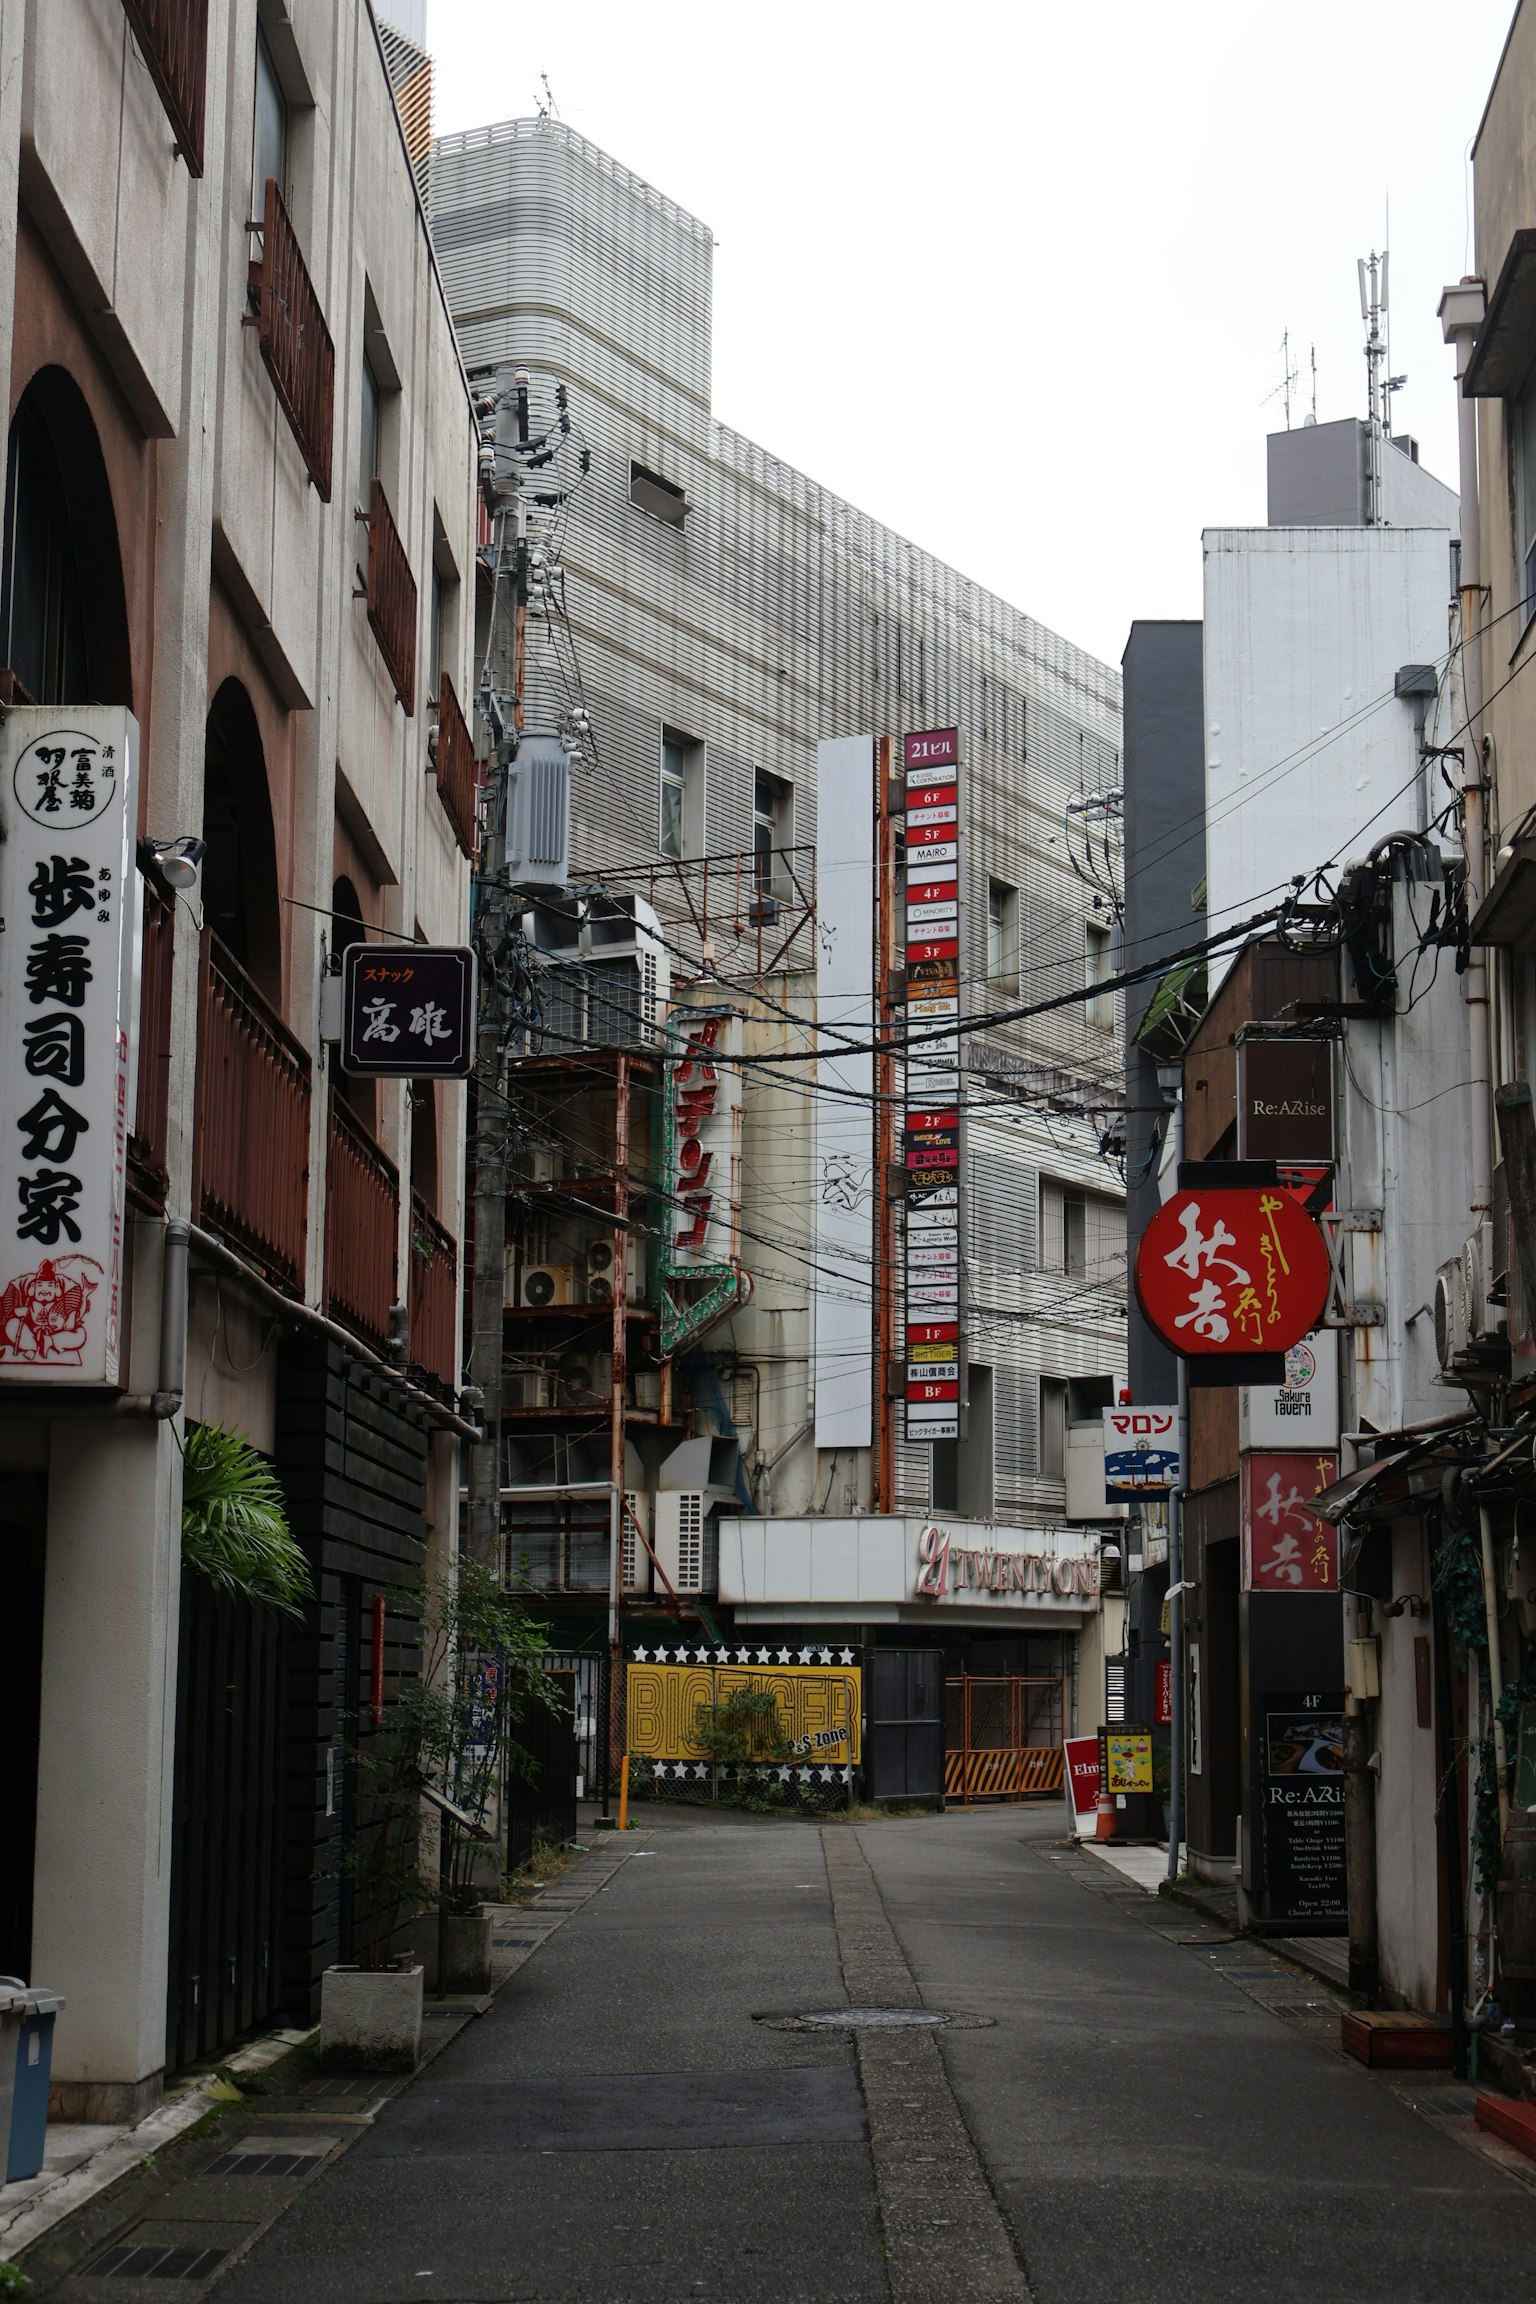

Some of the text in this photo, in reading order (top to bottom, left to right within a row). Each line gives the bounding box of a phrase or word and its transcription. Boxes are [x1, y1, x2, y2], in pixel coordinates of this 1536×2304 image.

[911, 741, 952, 758] 21ビル
[102, 745, 116, 778] 清酒
[70, 748, 96, 810] 富美菊
[916, 774, 955, 784] CORPORATION
[917, 848, 947, 859] MAIRO
[97, 867, 111, 923] あゆみ
[364, 967, 414, 983] スナック
[16, 854, 95, 1245] 歩寿司分家
[1279, 1389, 1311, 1402] Sakura
[1274, 1400, 1311, 1416] Tavern
[1111, 1415, 1172, 1434] マロン
[917, 1527, 1099, 1597] 21 TWENTY ONE
[1302, 1695, 1322, 1708] 4F
[630, 1671, 714, 1755] BIG
[814, 1728, 849, 1748] Zone
